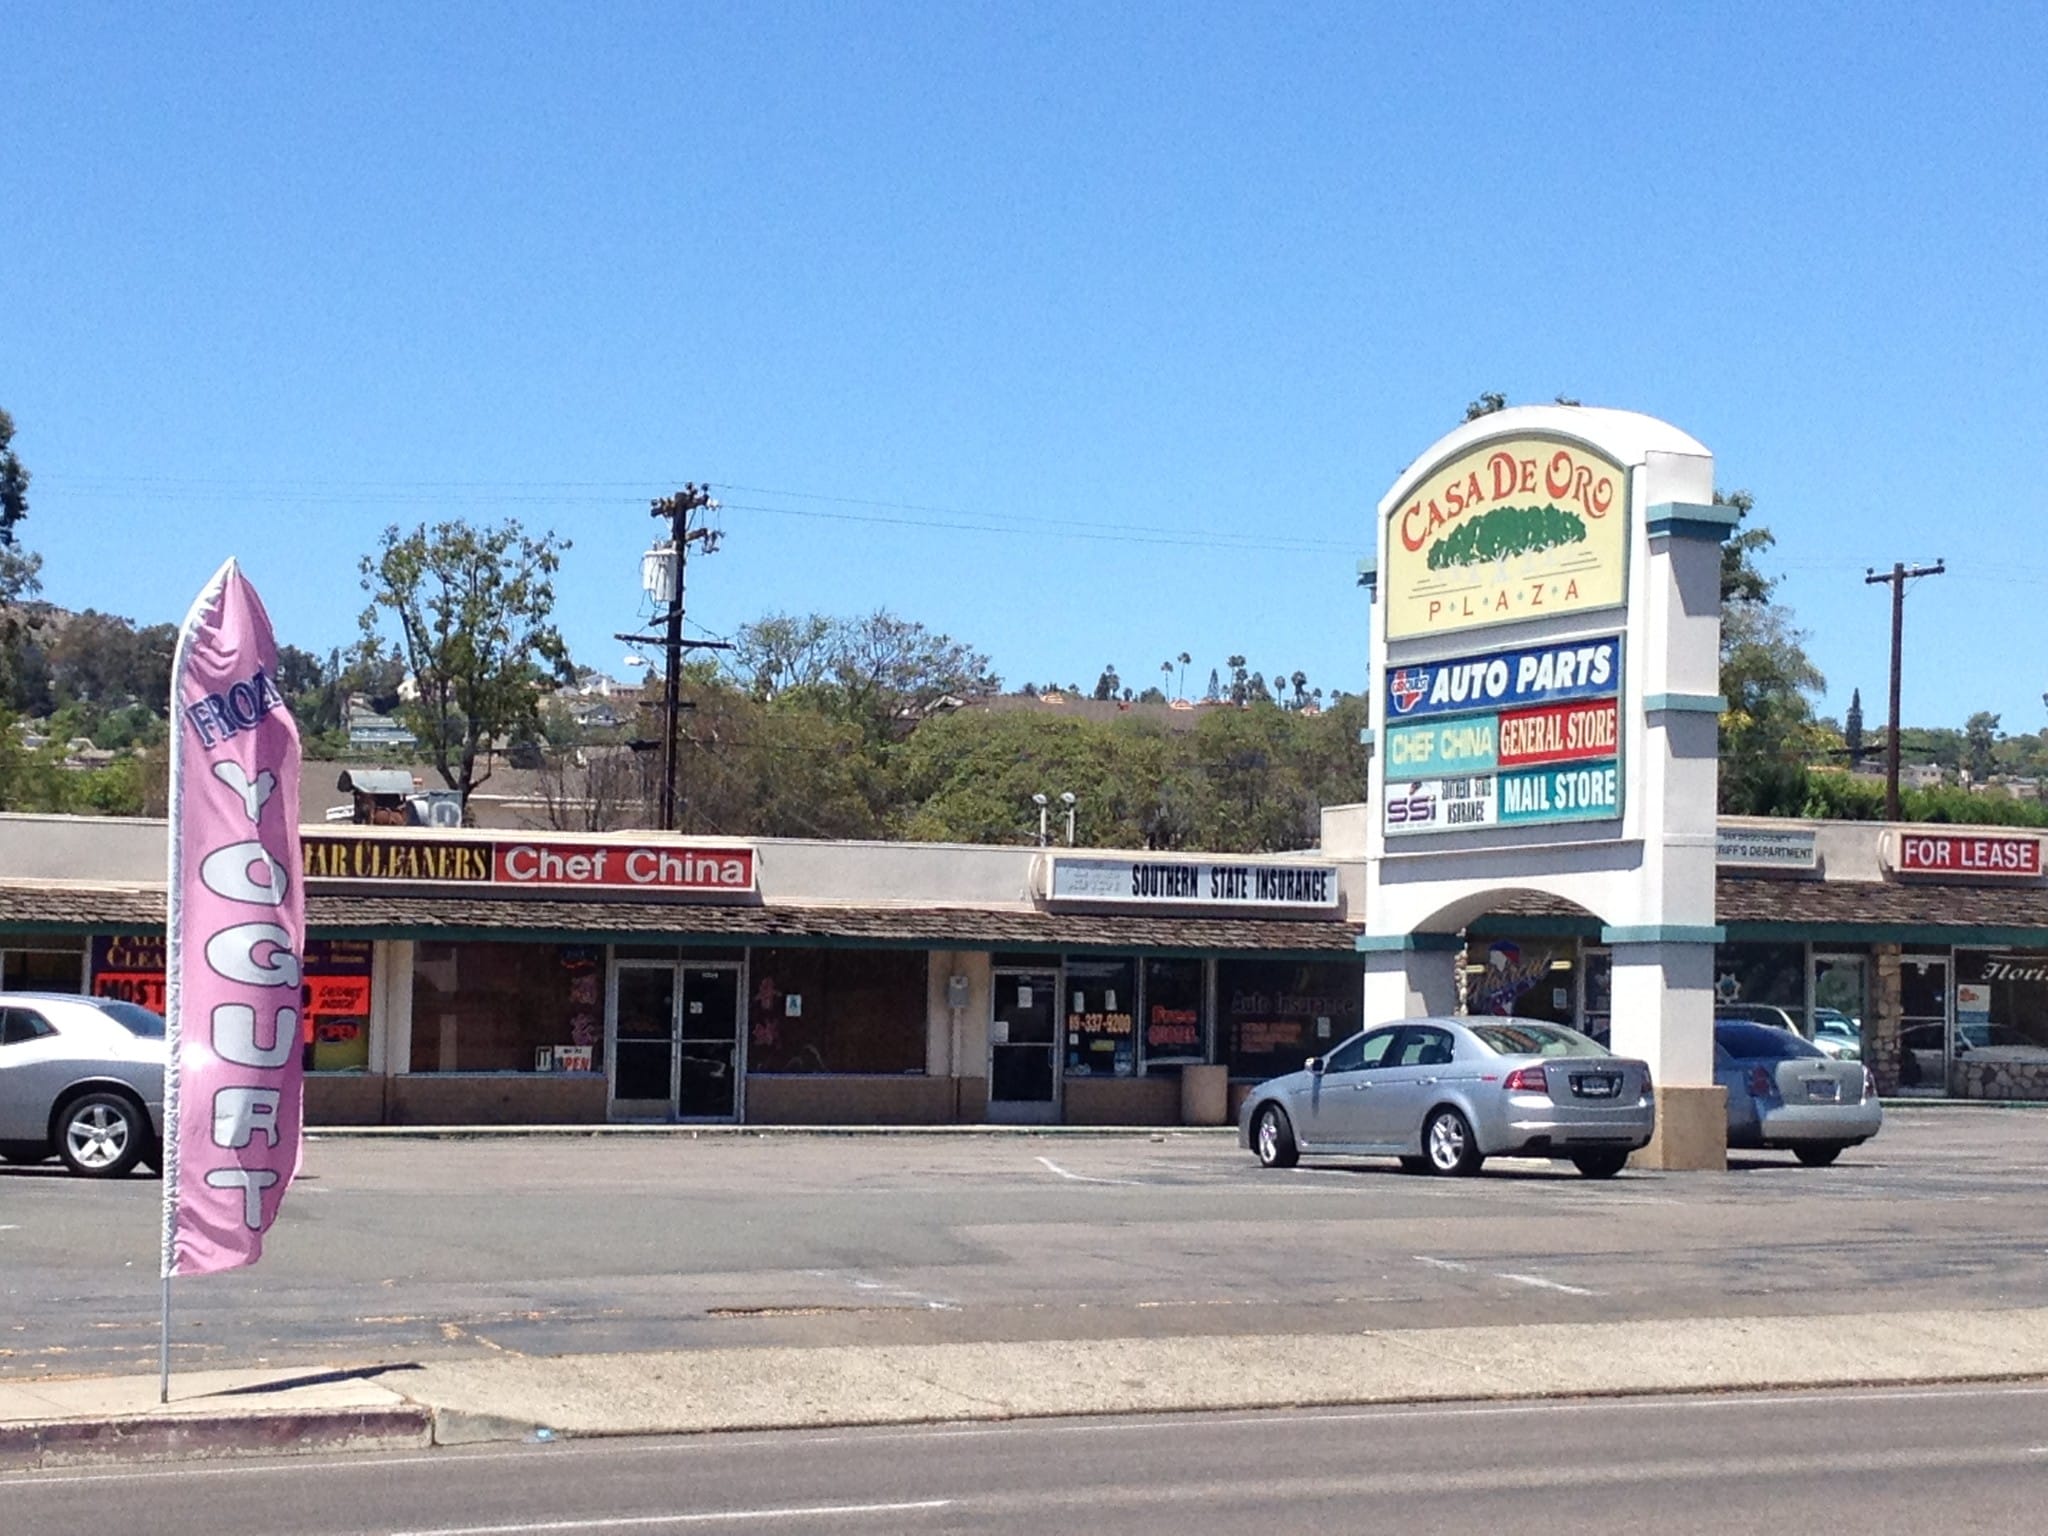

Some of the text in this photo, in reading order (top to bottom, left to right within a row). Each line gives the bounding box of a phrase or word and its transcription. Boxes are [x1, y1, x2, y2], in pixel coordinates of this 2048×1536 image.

[1401, 450, 1613, 552] CASA DE ORO
[1429, 645, 1613, 704] AUTO PARTS
[1393, 726, 1493, 765] CHEF CHINA
[1500, 708, 1616, 757] GENERAL STORE
[1503, 769, 1616, 814] MAIL STORE
[354, 839, 487, 880] CLEANERS
[504, 844, 746, 885] Chef China
[1904, 838, 2033, 869] FOR LEASE
[1131, 863, 1199, 898] SOUTHERN
[1211, 866, 1248, 900] STATE
[1255, 867, 1328, 903] INSURANCE
[201, 759, 298, 1232] YOGURT
